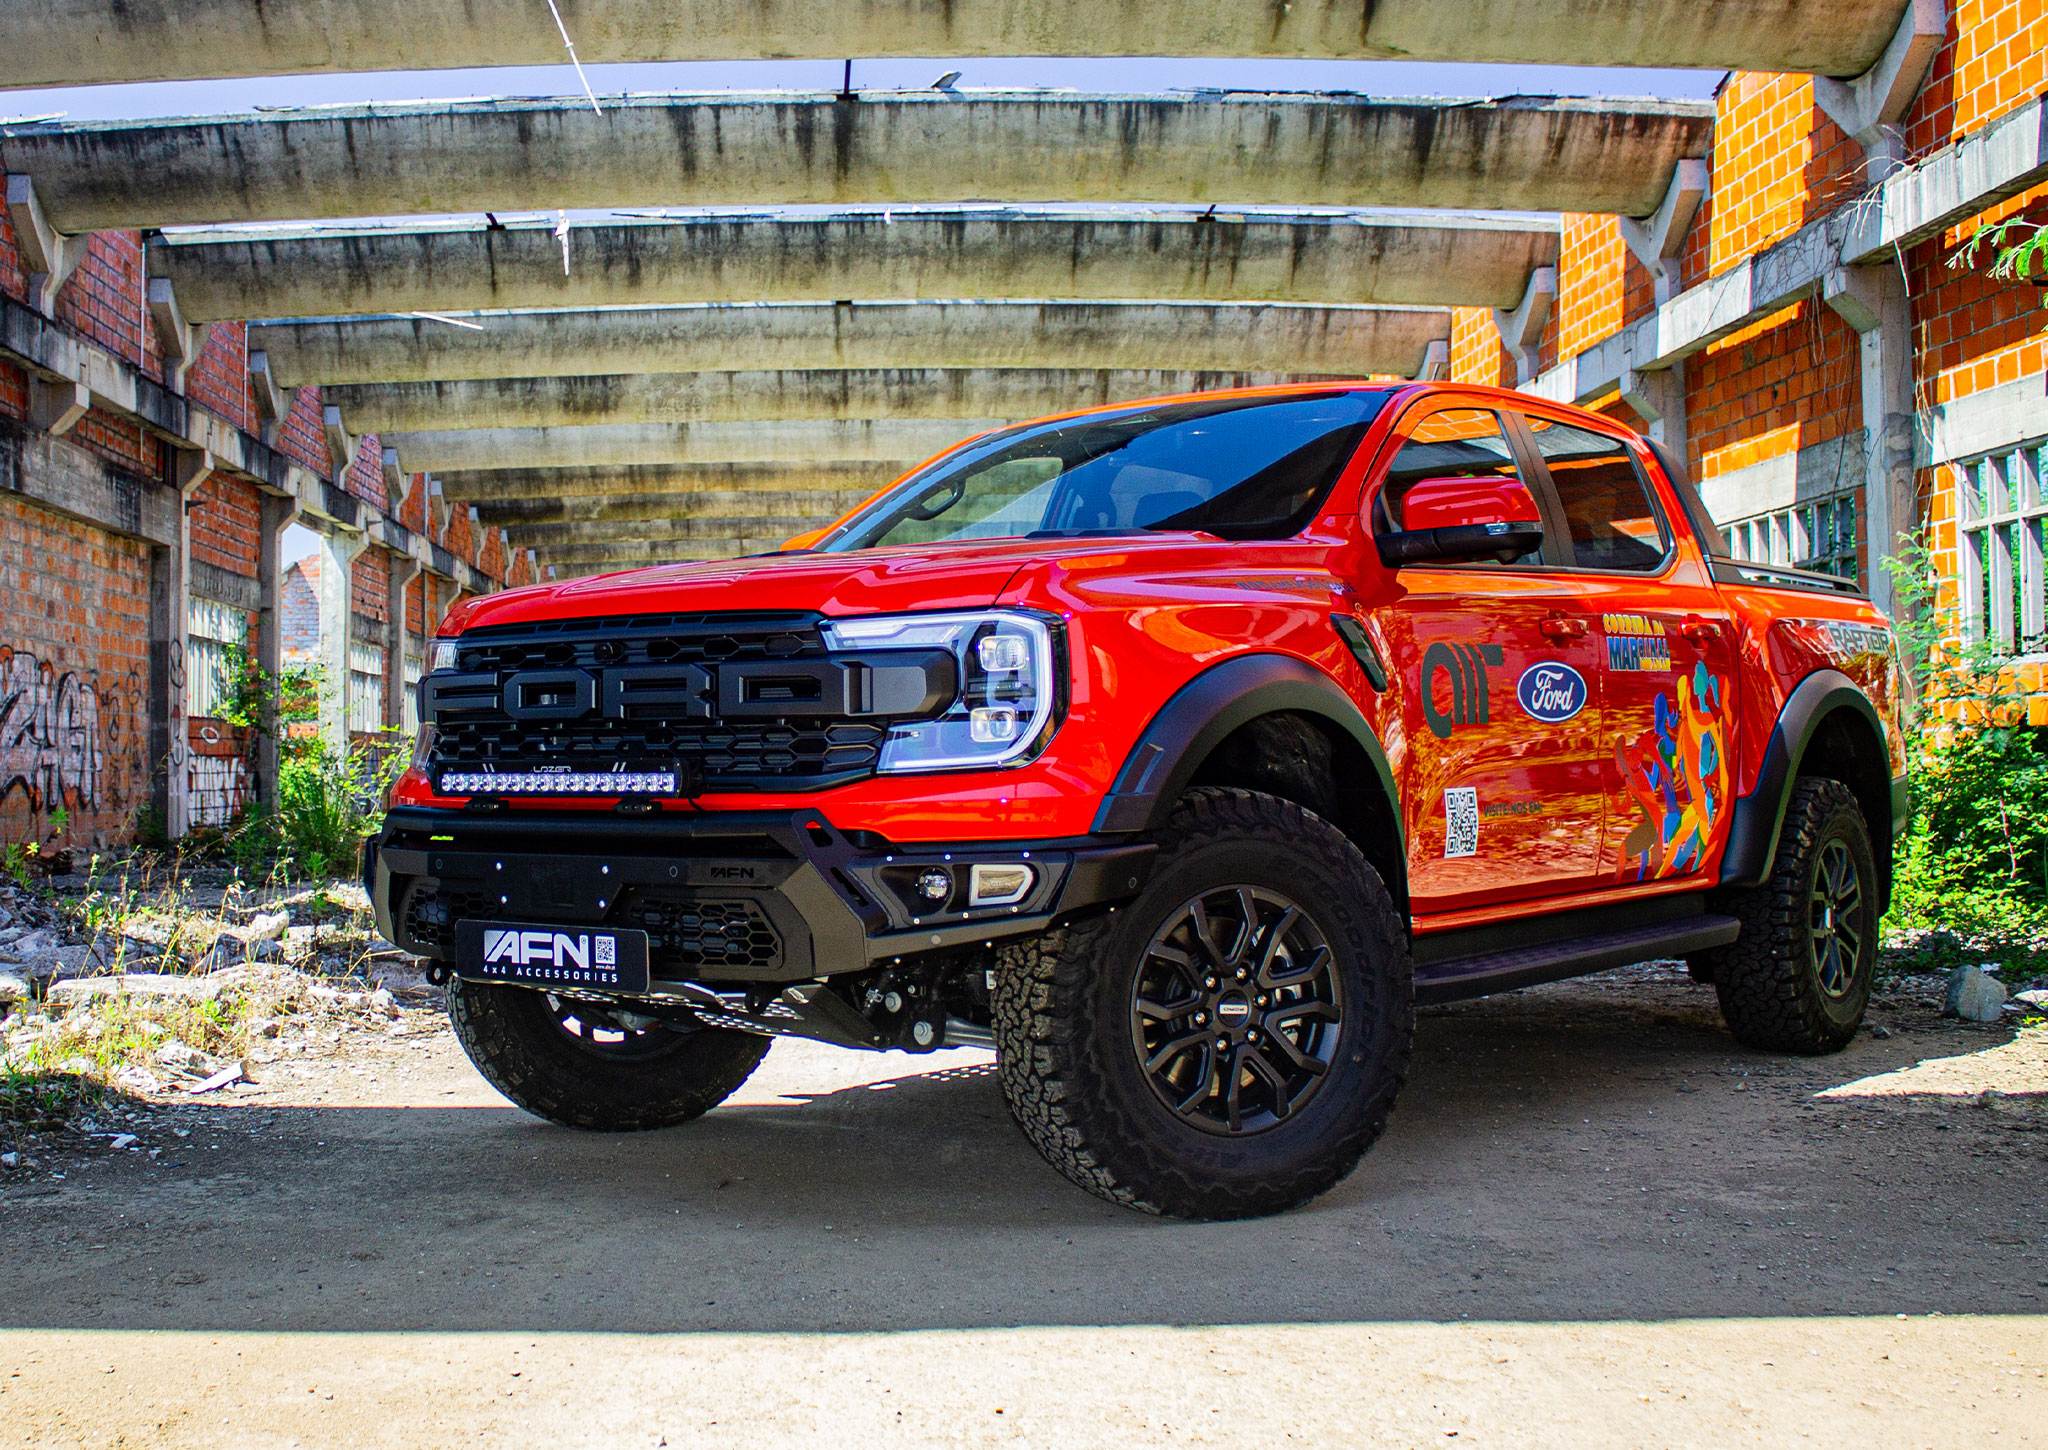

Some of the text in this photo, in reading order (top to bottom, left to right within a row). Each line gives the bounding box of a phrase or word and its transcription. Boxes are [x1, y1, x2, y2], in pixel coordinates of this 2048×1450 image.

[1828, 626, 1892, 658] RAPTOR
[416, 663, 849, 724] FORD
[710, 866, 754, 879] AFN
[484, 930, 590, 968] AFN
[483, 964, 618, 983] 4x4 ACCESSORIES
